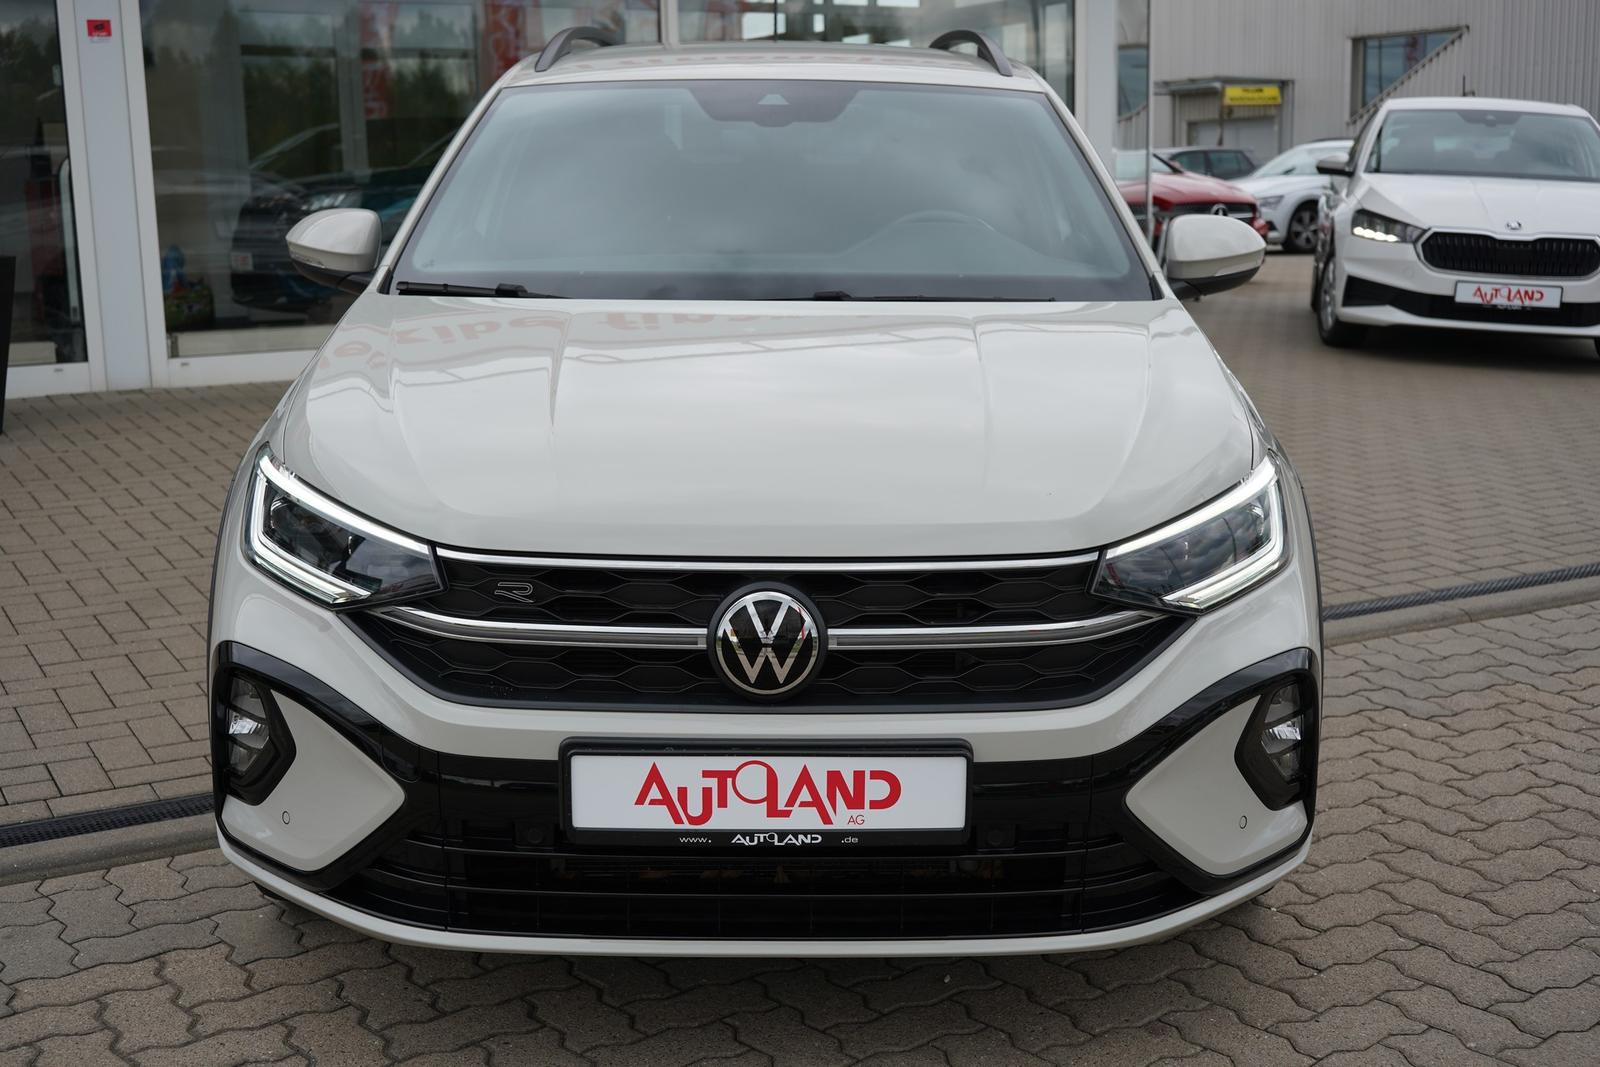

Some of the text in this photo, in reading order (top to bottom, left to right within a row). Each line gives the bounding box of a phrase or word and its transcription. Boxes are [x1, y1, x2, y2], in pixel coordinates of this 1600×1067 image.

[1473, 285, 1545, 305] AUTOLAND
[714, 591, 819, 696] VW
[633, 759, 902, 826] AUTOLAND
[847, 814, 866, 826] AG
[679, 832, 859, 846] www. AUTOLAND .de
